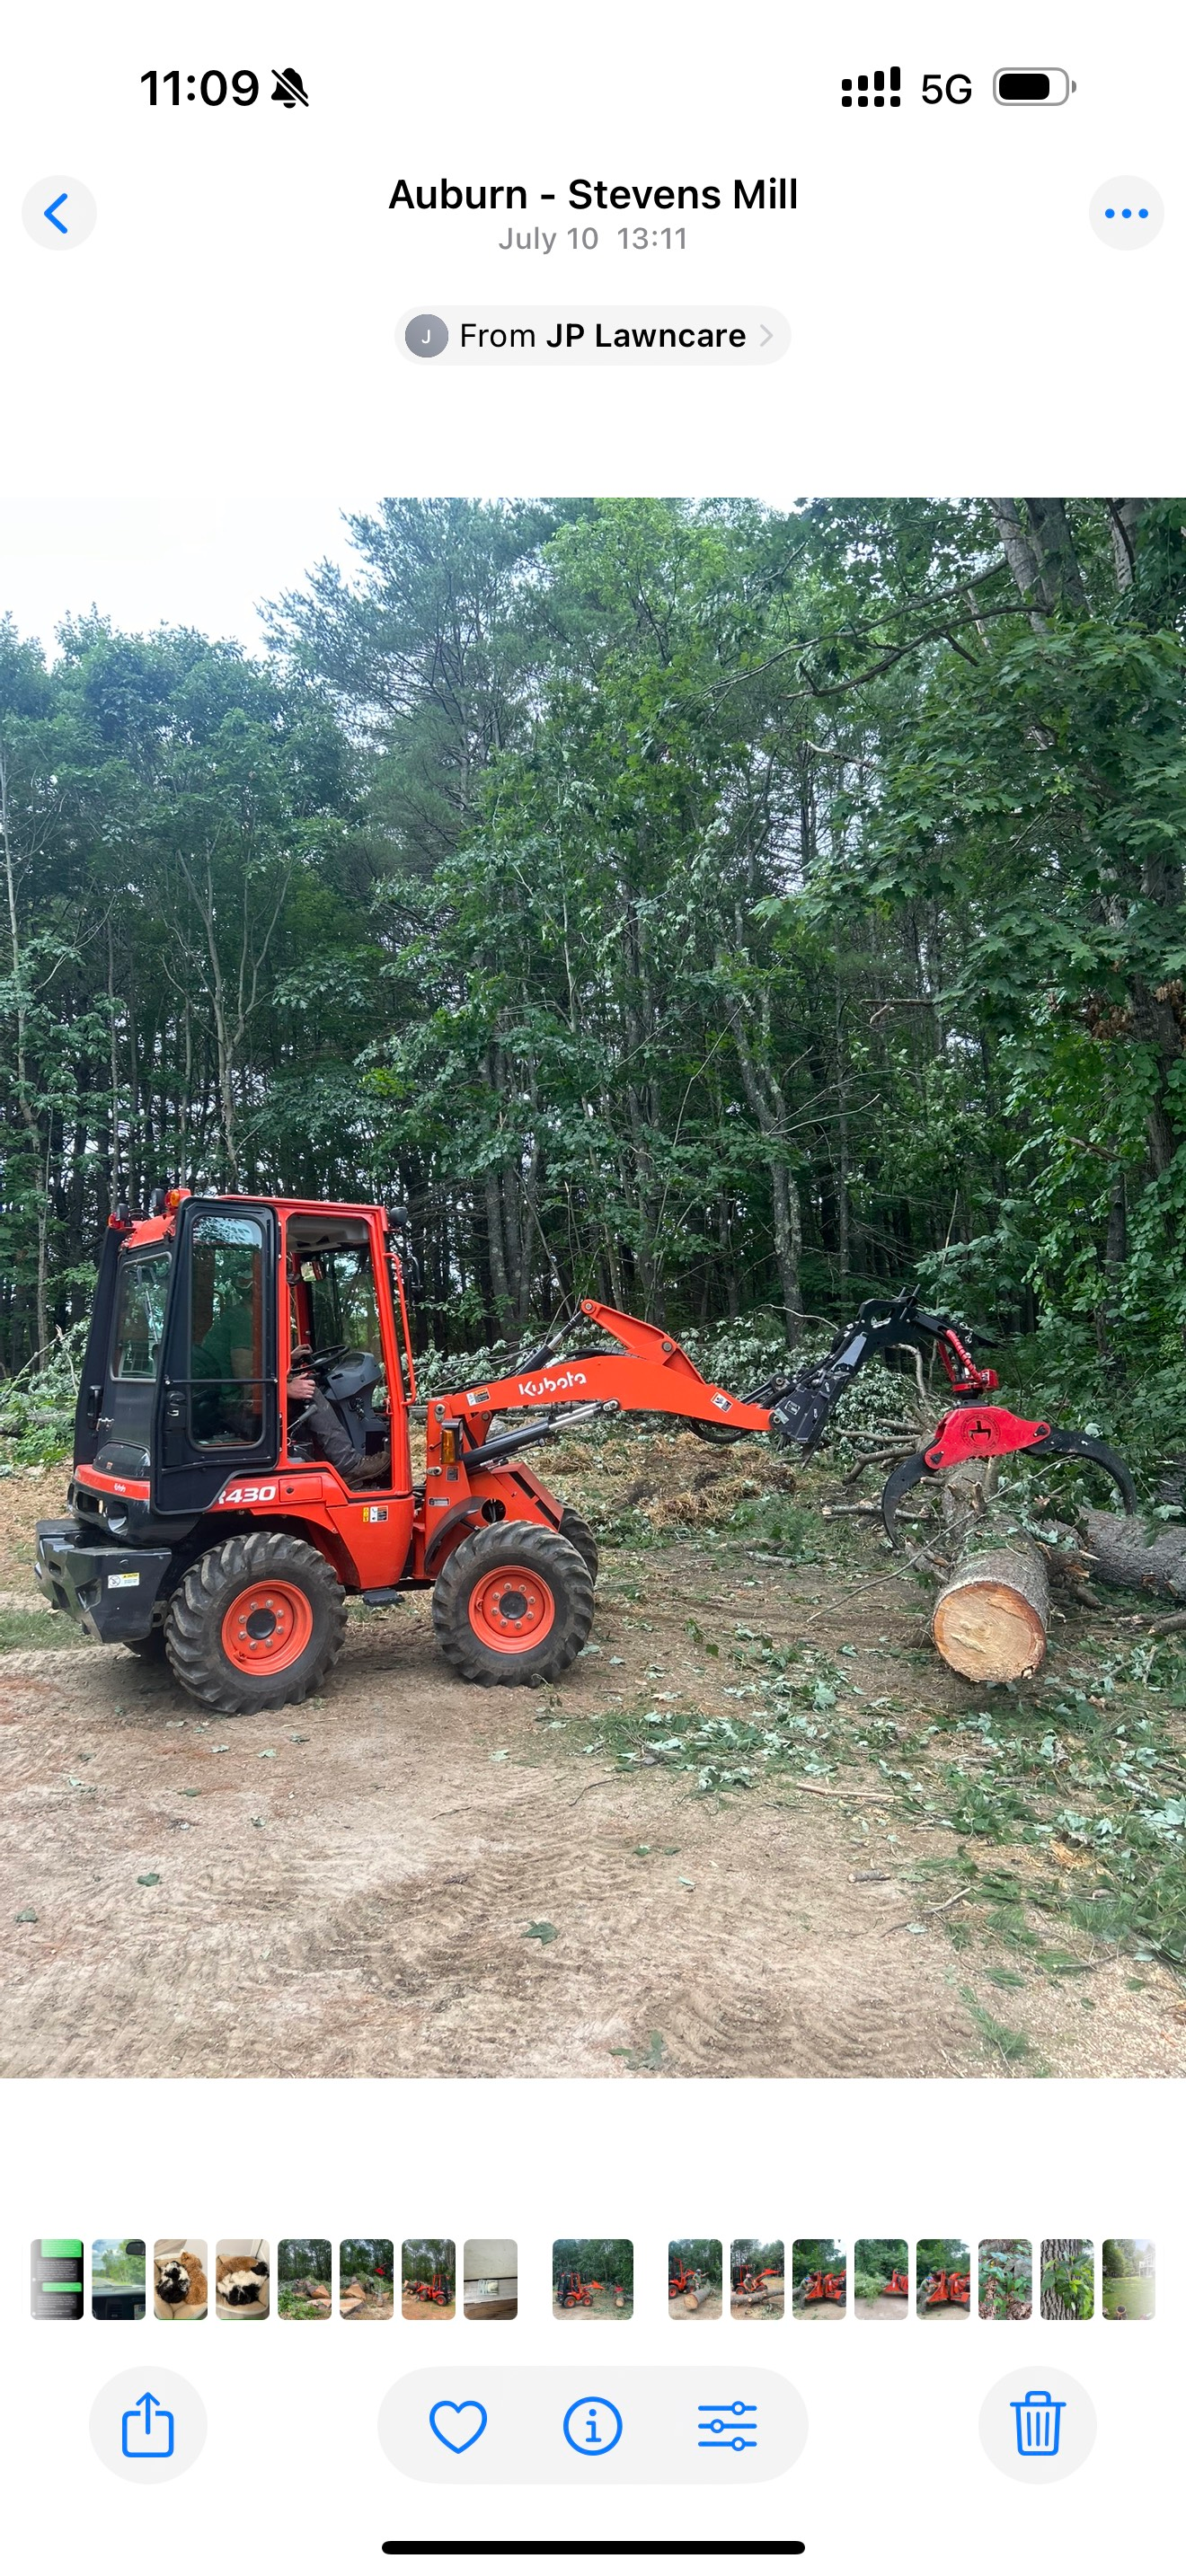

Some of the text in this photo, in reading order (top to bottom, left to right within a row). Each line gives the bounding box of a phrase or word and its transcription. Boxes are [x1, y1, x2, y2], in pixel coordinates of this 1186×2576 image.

[140, 70, 260, 106] 11:09
[921, 73, 972, 105] 5G
[388, 177, 527, 210] Auburn
[568, 178, 721, 210] Stevens
[734, 176, 797, 209] Mill
[498, 226, 686, 255] July 10 13:11
[421, 329, 431, 344] J
[461, 322, 747, 348] From JP Lawncare
[518, 1371, 587, 1397] Kubota
